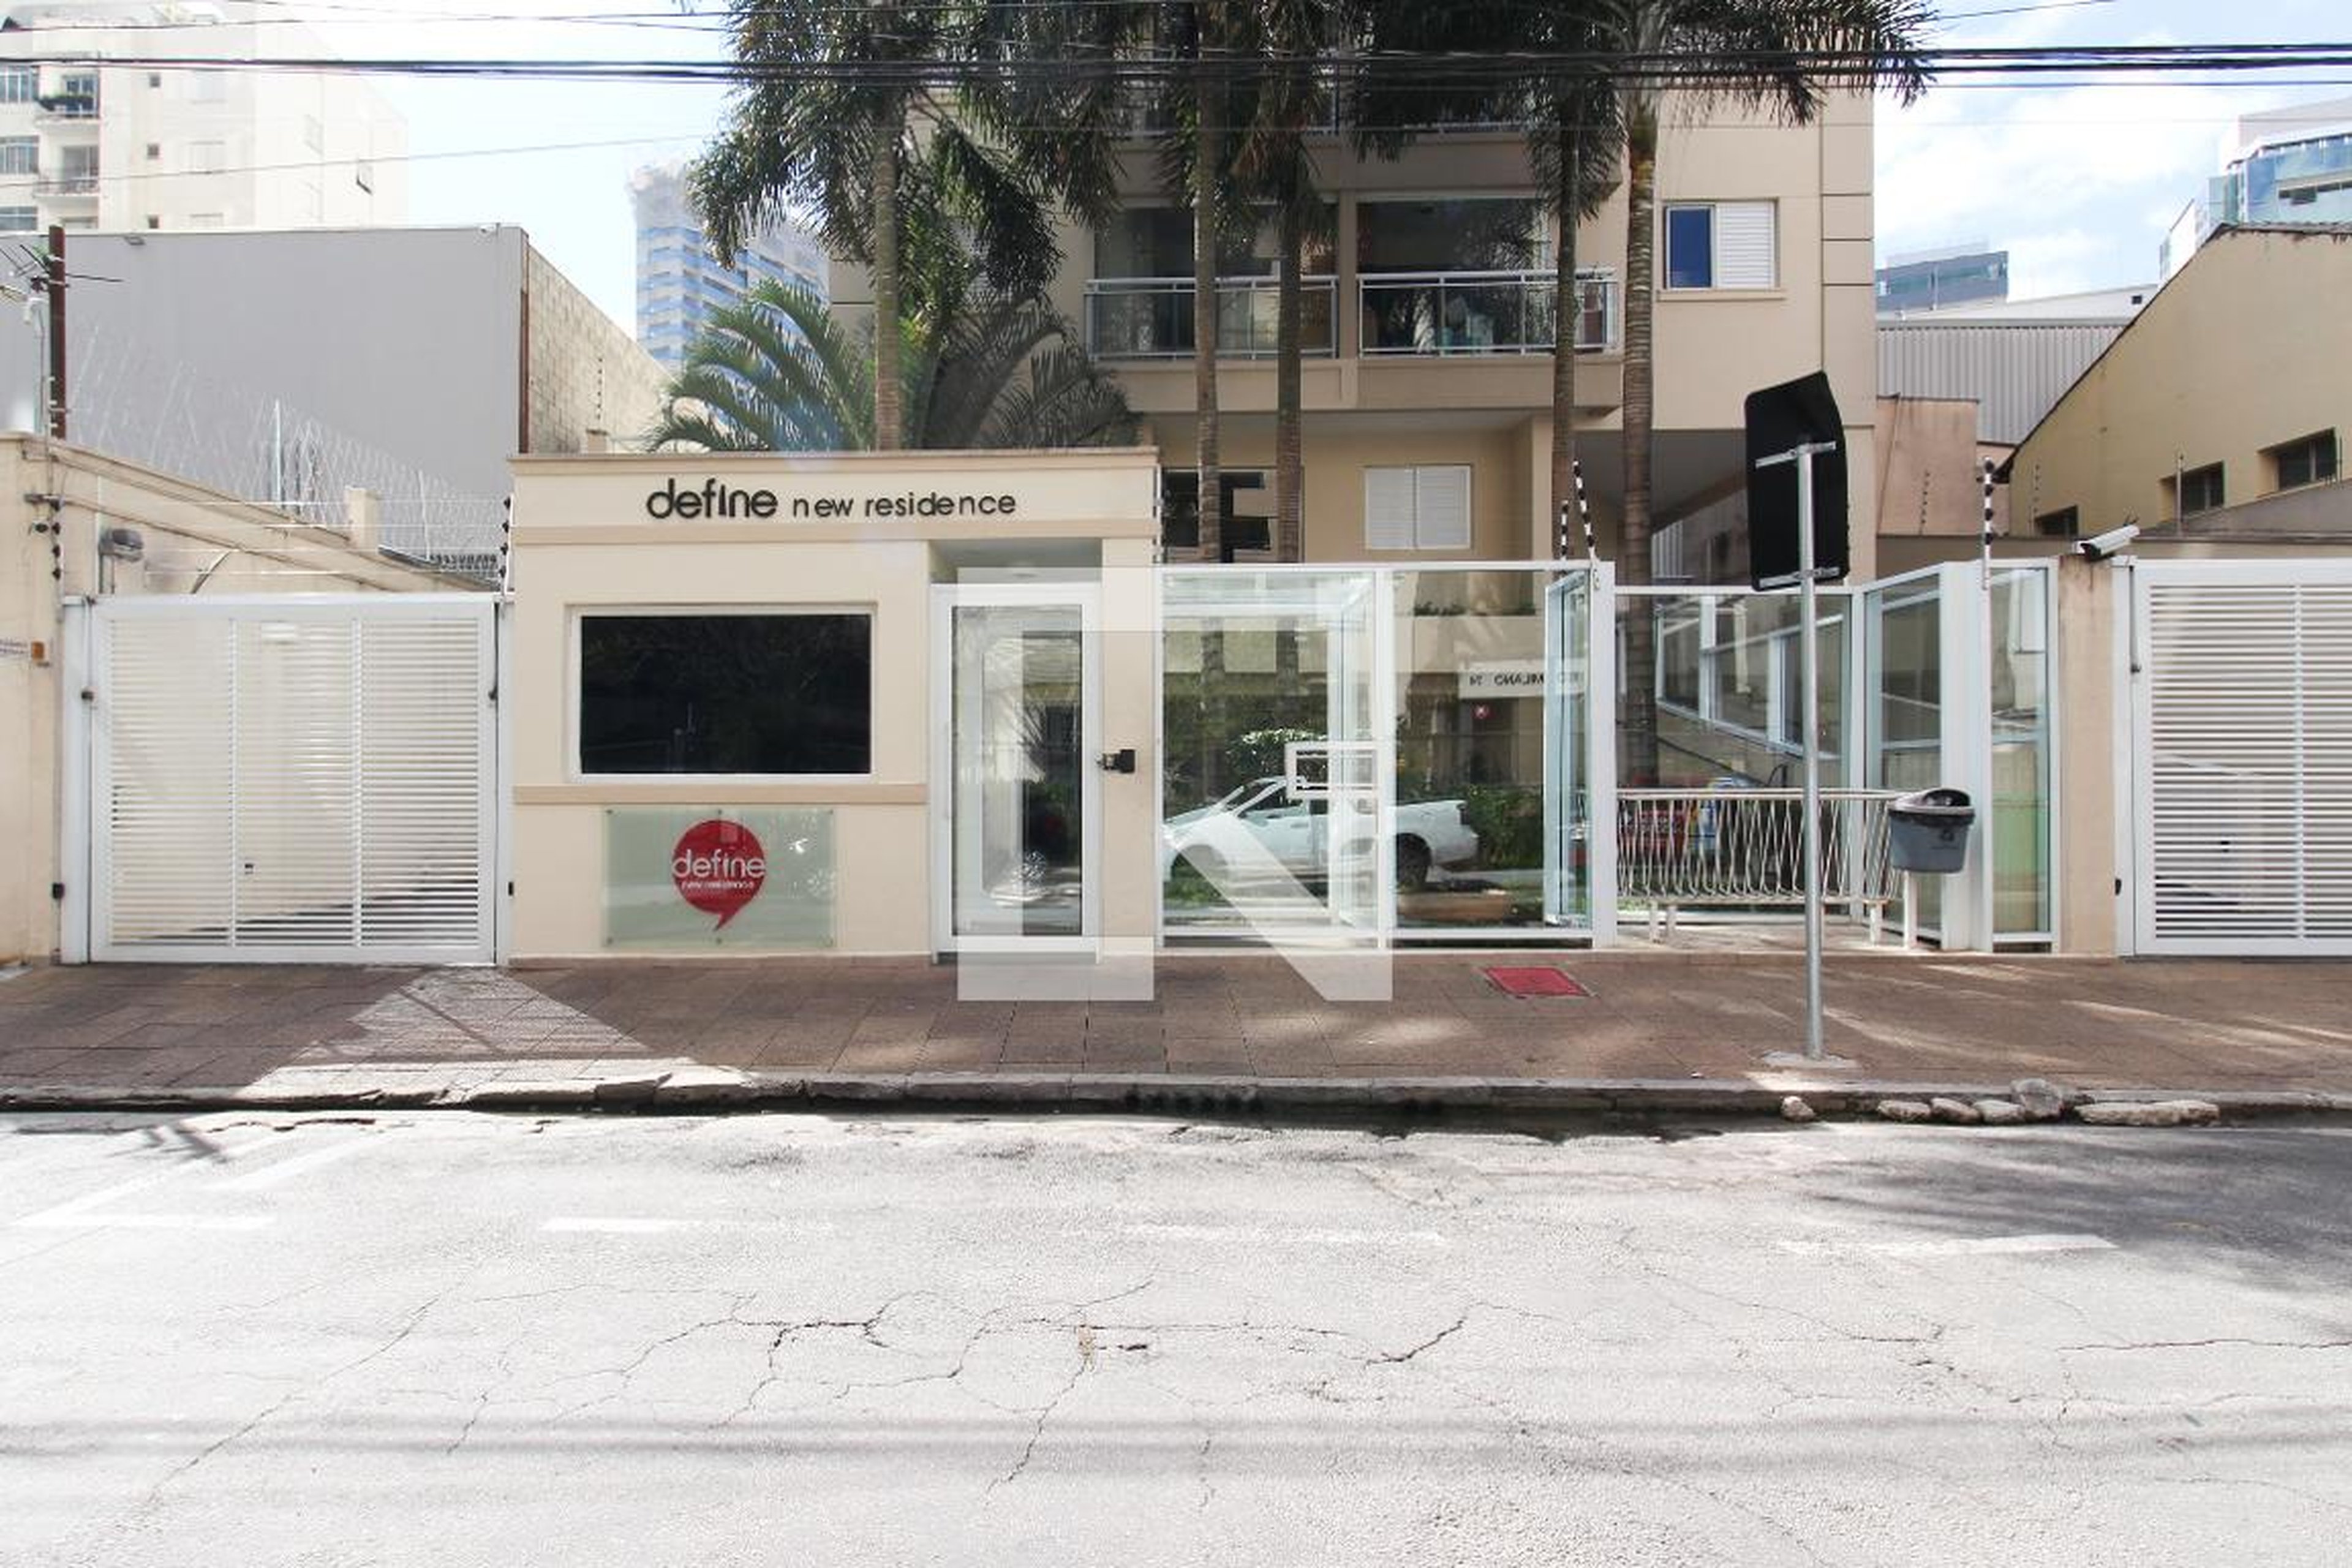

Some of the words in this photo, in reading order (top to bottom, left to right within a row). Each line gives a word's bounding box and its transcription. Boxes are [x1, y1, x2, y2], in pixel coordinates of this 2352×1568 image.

[646, 478, 778, 519] define
[793, 498, 854, 518] new
[864, 491, 1016, 518] residence
[672, 848, 765, 878] define
